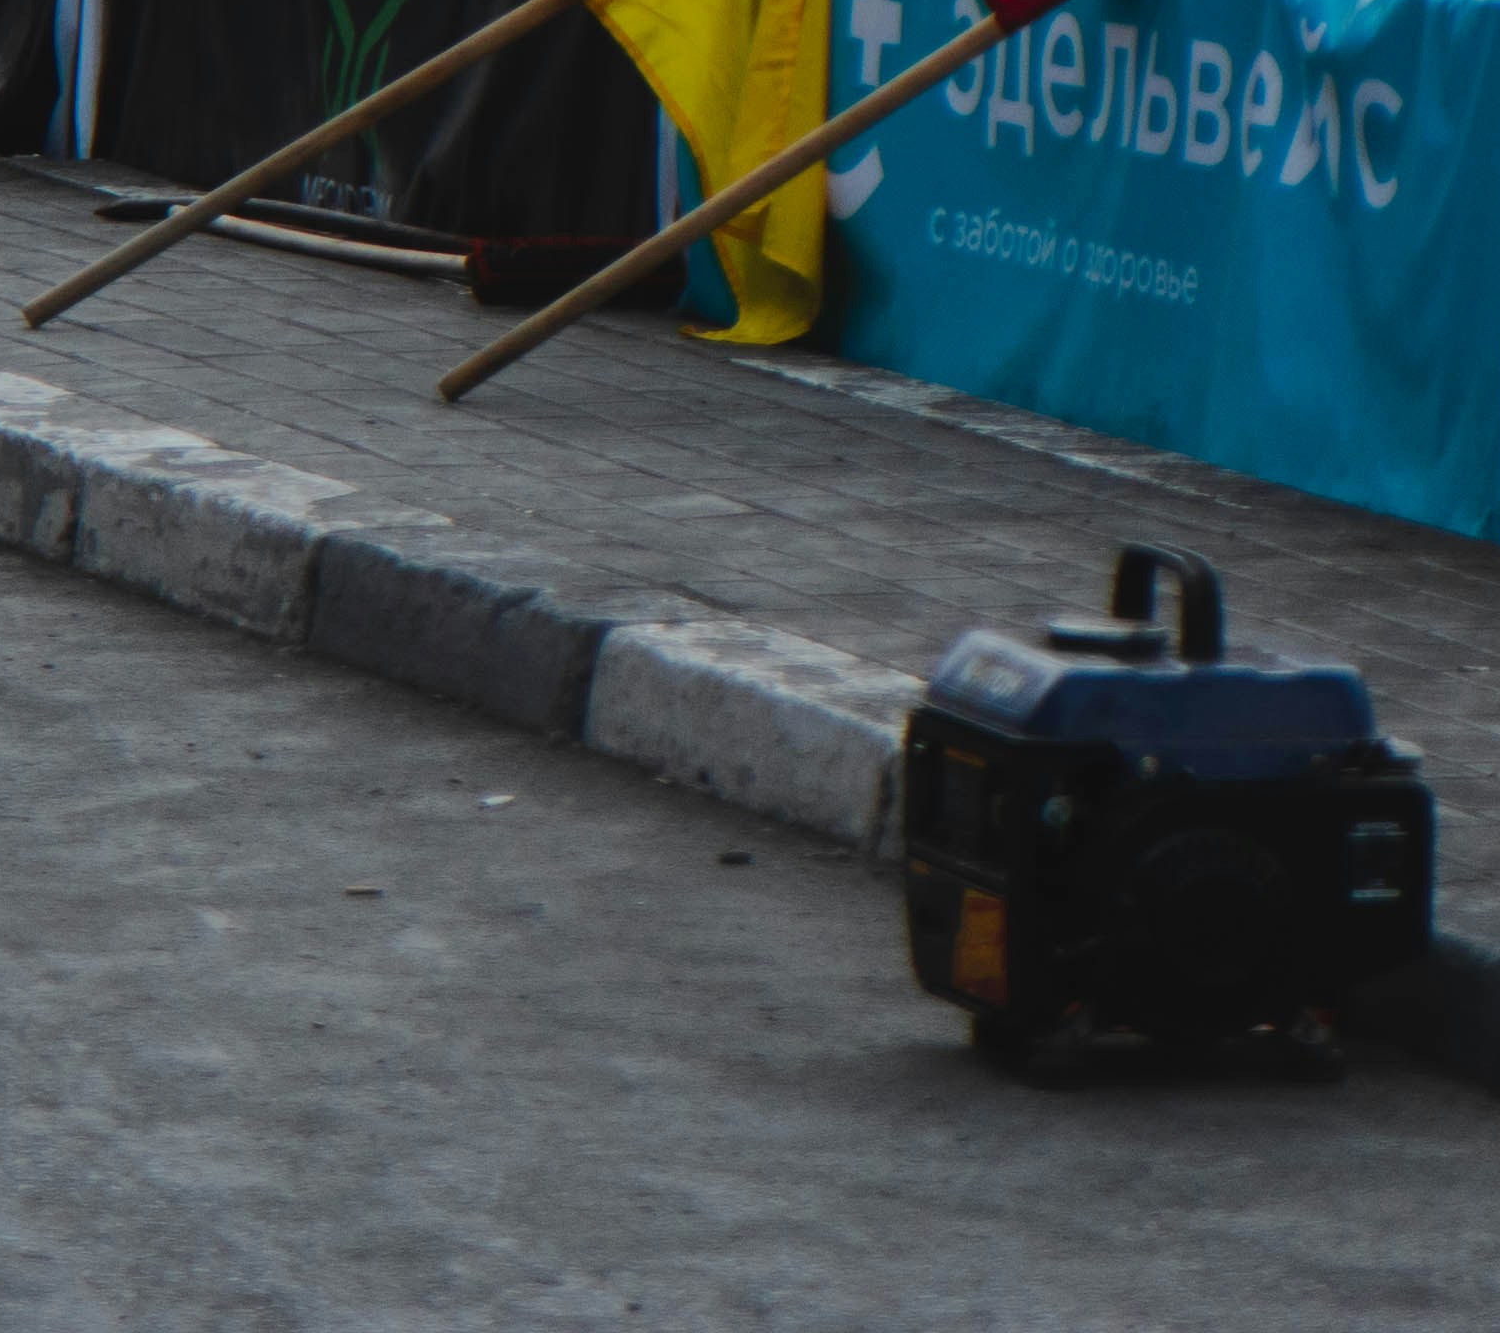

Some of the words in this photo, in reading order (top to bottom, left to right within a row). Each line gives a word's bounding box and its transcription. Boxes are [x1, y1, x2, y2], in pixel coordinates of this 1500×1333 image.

[929, 206, 946, 245] с
[953, 209, 1057, 272] заботой
[1062, 235, 1078, 275] о
